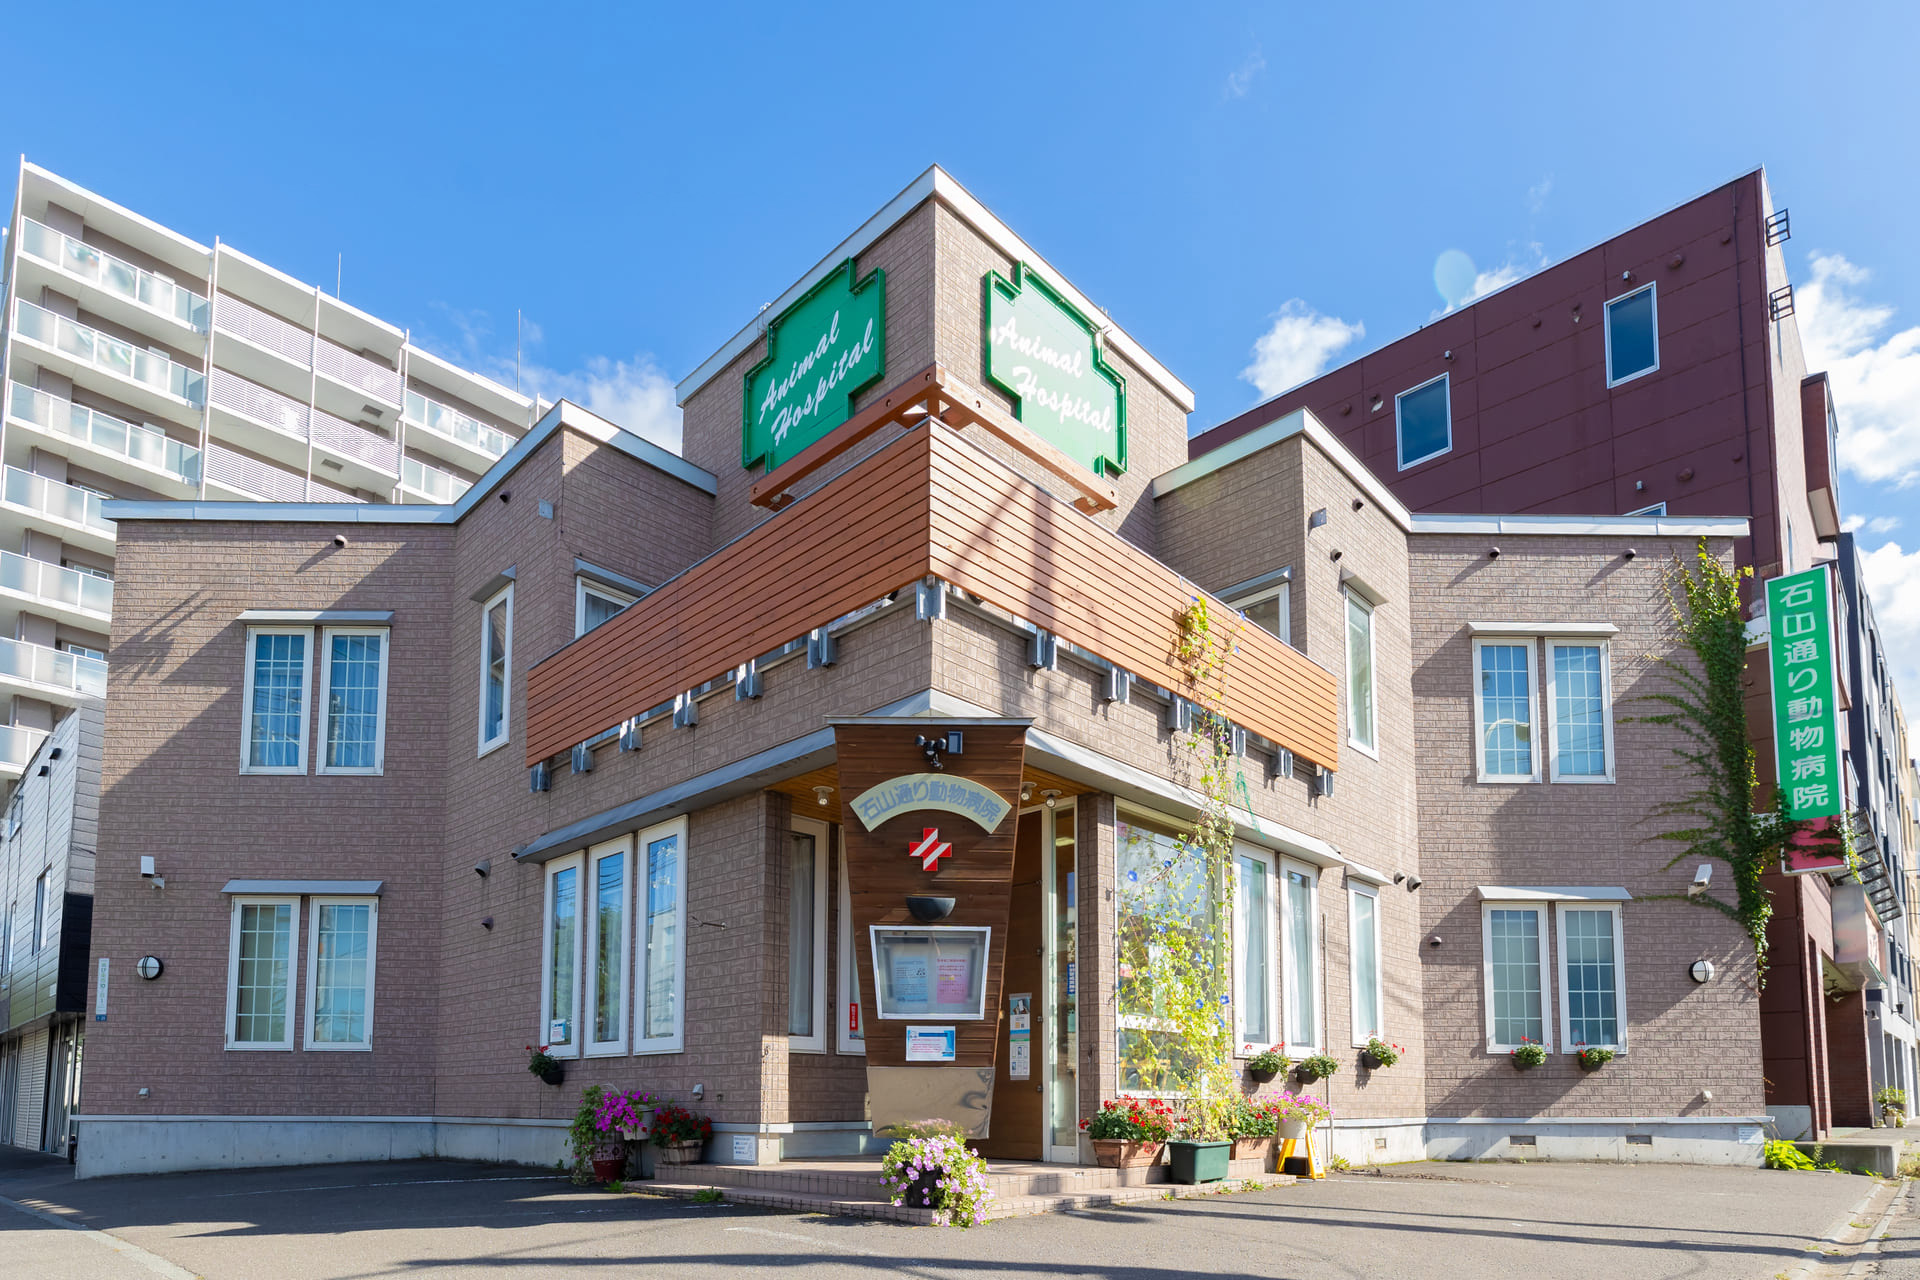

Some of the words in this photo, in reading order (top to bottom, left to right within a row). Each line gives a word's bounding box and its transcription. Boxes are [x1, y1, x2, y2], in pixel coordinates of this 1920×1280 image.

[758, 310, 840, 425] Animal
[770, 318, 875, 446] Hospital
[990, 316, 1083, 379] Animal
[1011, 365, 1113, 434] Hospital
[858, 780, 1002, 823] 石山通り動物病院
